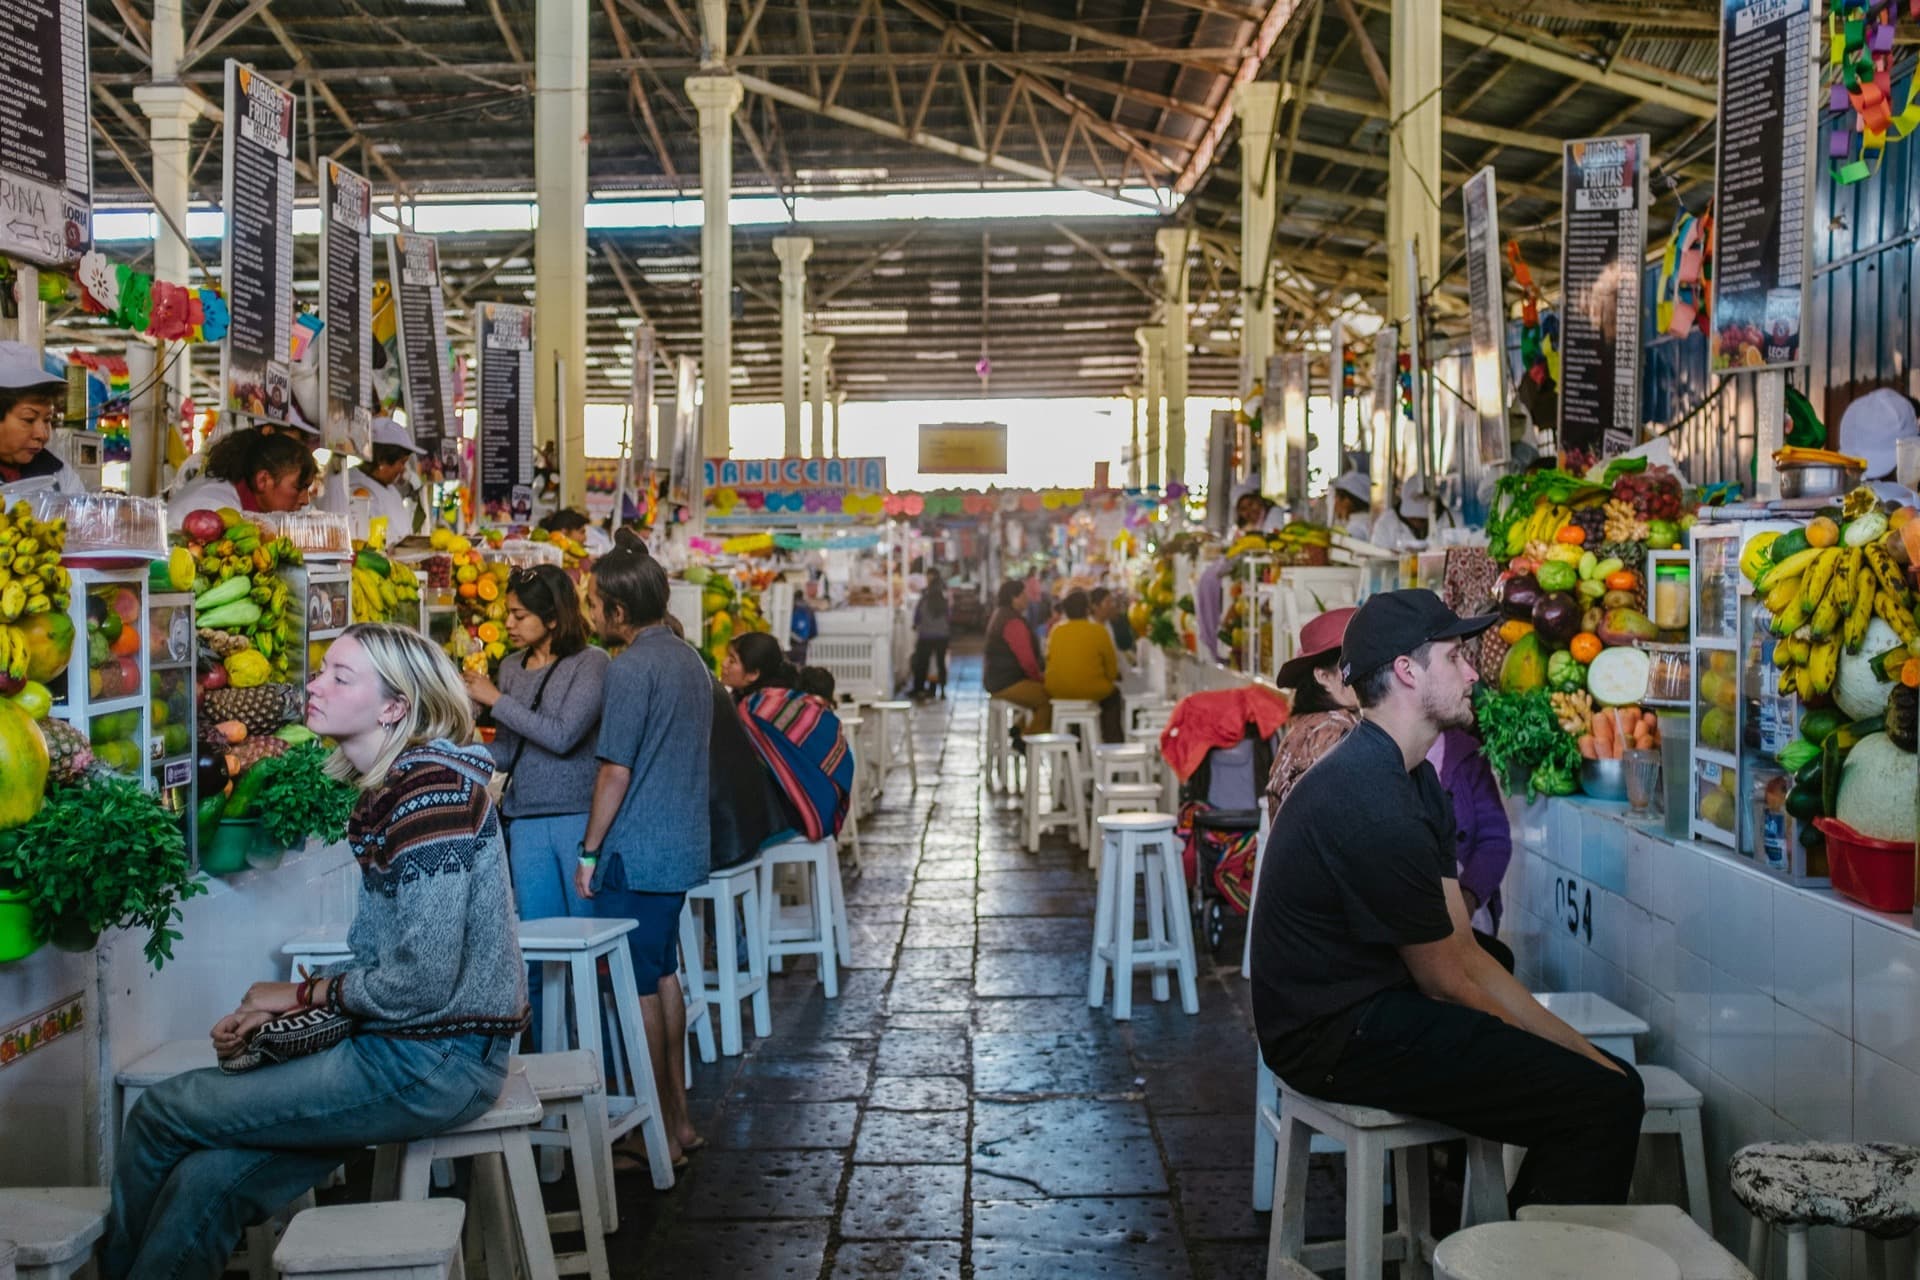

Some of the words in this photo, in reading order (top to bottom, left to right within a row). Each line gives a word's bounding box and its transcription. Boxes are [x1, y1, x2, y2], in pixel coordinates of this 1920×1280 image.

[248, 75, 276, 108] JUGOS
[248, 99, 281, 133] FRUTAS
[1582, 142, 1617, 164] JUGOS
[1584, 167, 1624, 189] FRUTAS
[42, 230, 61, 259] 59
[1768, 345, 1790, 358] LECHE
[1555, 876, 1593, 945] 054
